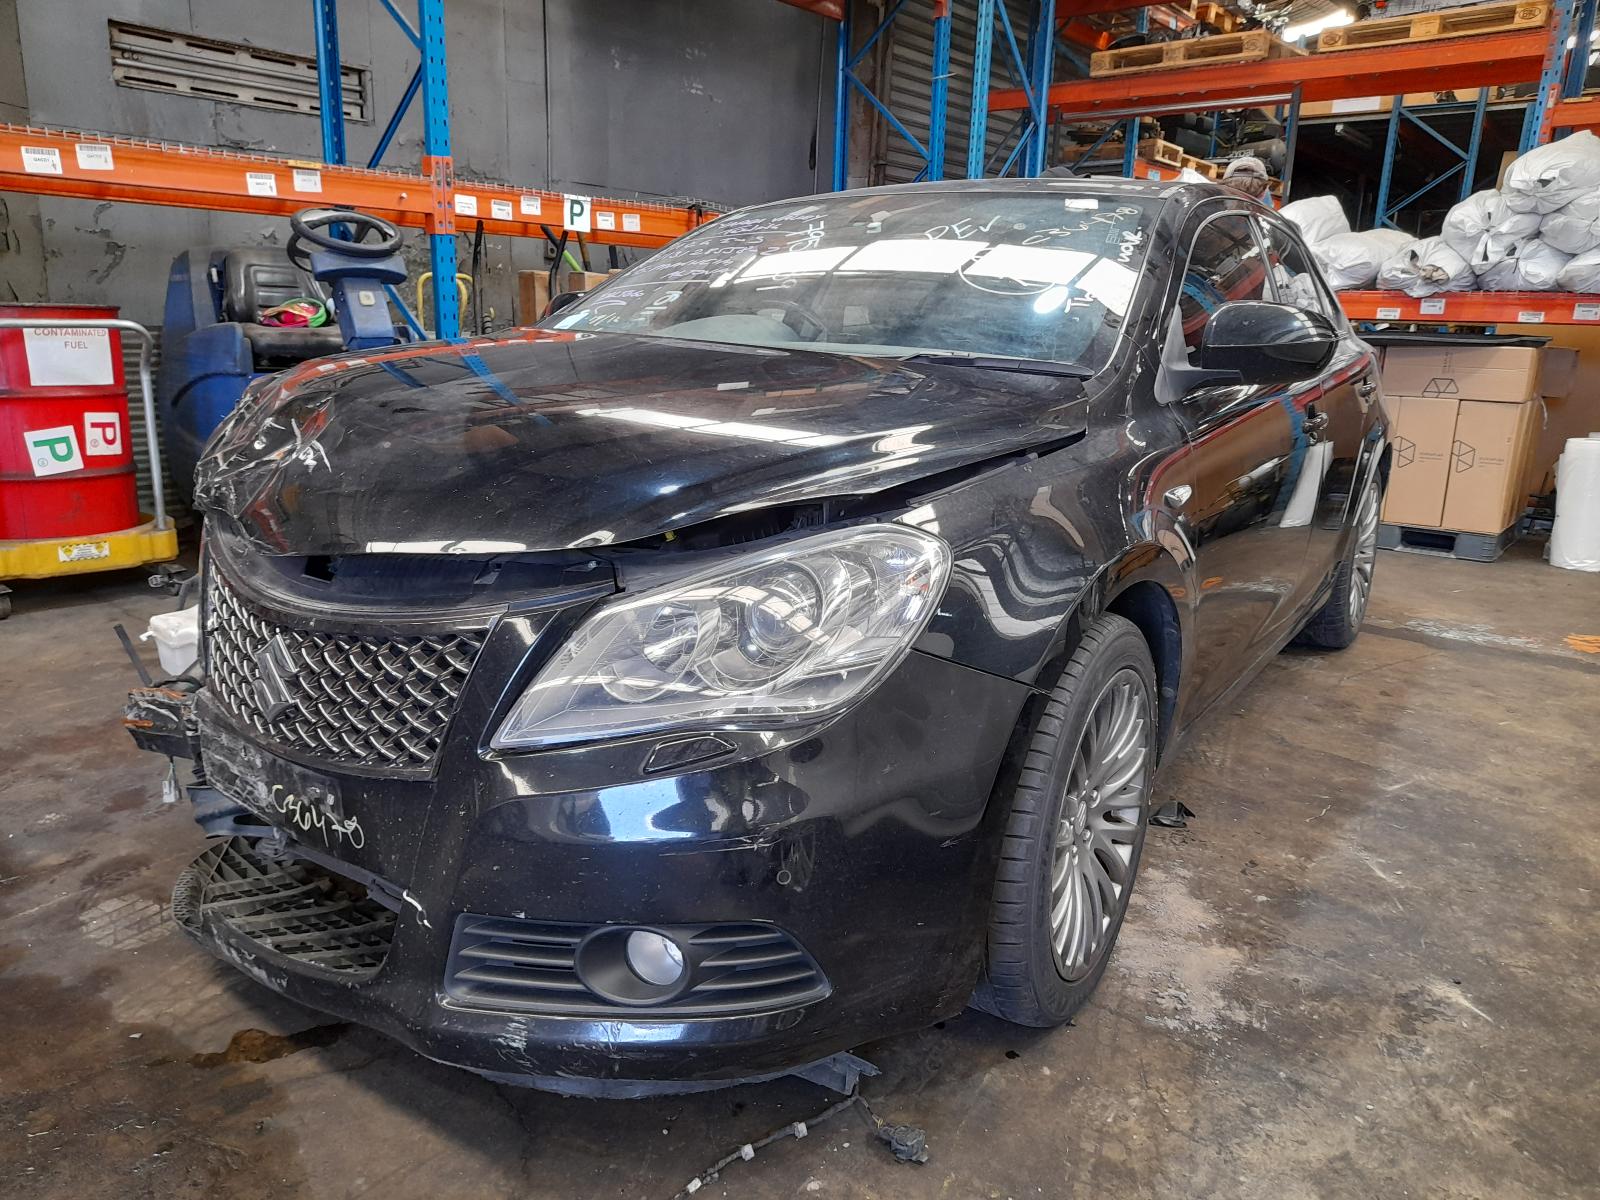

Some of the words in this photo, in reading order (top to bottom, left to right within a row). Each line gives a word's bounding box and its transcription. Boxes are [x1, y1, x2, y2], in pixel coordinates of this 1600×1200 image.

[569, 199, 584, 226] P
[34, 328, 107, 337] CONTAMINATED
[64, 341, 88, 350] FUEL
[90, 422, 117, 446] P
[32, 436, 74, 463] P
